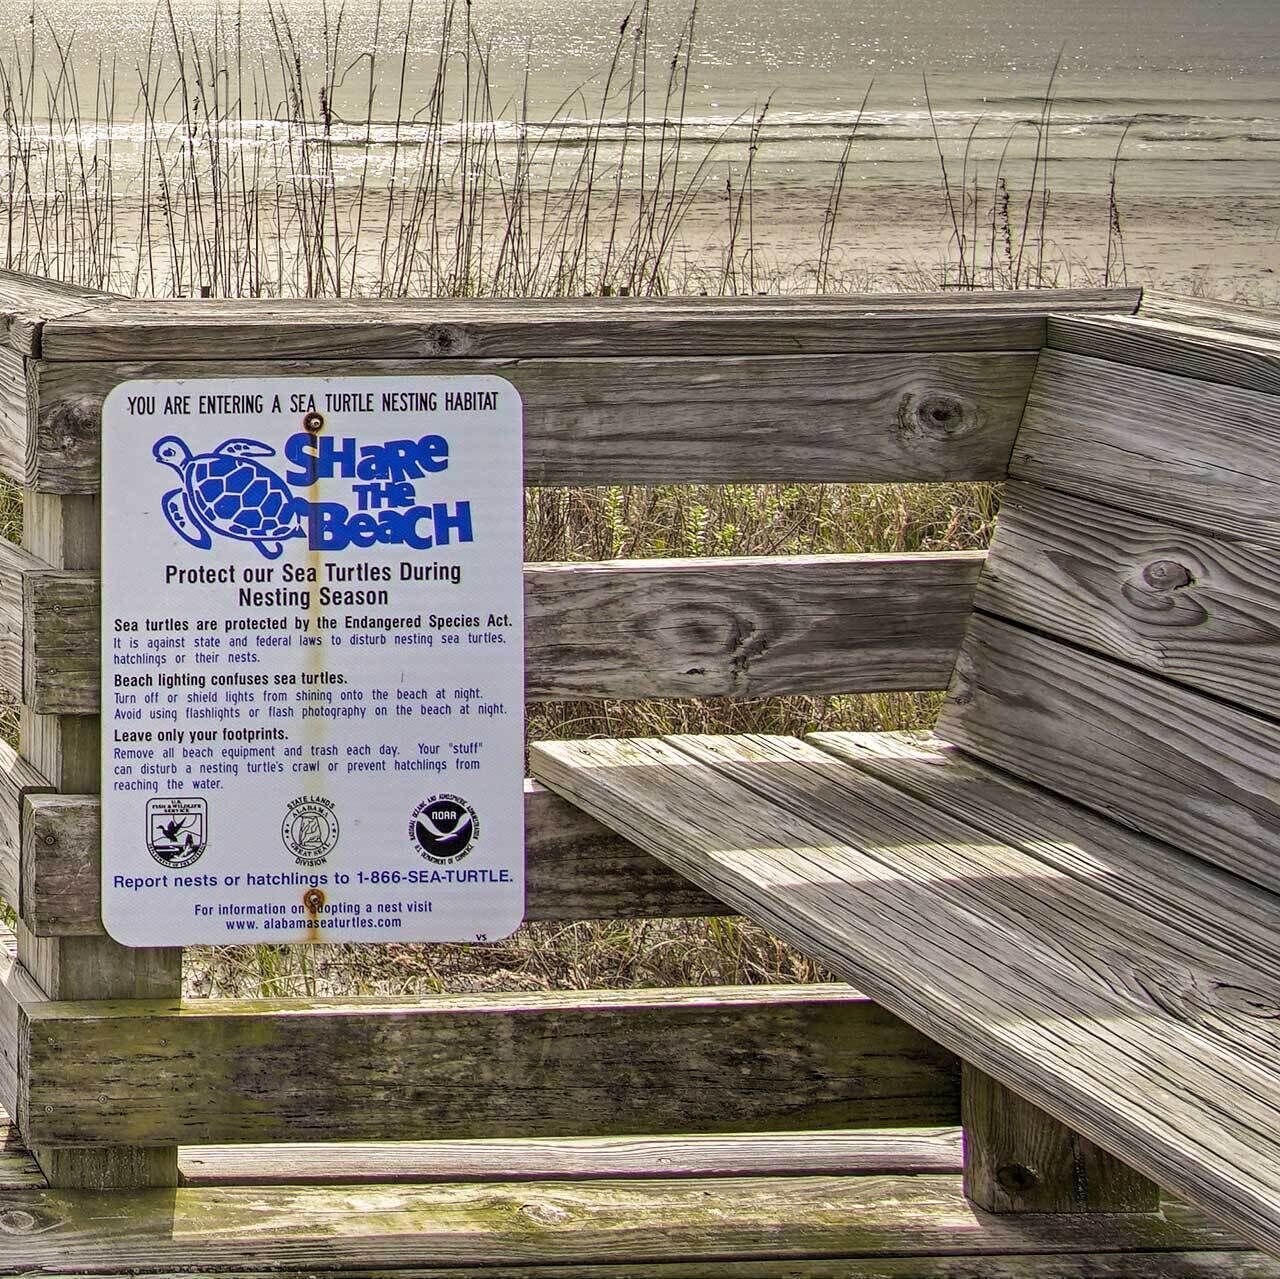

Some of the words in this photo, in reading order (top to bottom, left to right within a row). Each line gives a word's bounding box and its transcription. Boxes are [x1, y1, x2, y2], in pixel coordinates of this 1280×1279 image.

[127, 396, 155, 415] YOU
[164, 396, 191, 415] ARE
[199, 395, 263, 414] ENTERING
[272, 395, 281, 413] A
[290, 394, 316, 413] SEA
[325, 393, 374, 412] TURTLE
[382, 392, 437, 412] NESTING
[445, 392, 498, 411] HABITAT
[166, 565, 235, 584] Protect
[243, 568, 274, 583] our
[282, 563, 316, 582] Sea
[325, 563, 391, 582] Turtles
[400, 562, 460, 584] During
[239, 588, 310, 610] Nesting
[320, 587, 388, 605] Season
[115, 619, 138, 632] Sea
[145, 618, 188, 631] turtles
[197, 620, 217, 630] are
[225, 617, 287, 633] protected
[295, 617, 309, 632] by
[317, 616, 337, 629] the
[345, 615, 421, 631] Endangered
[429, 614, 480, 630] Species
[487, 614, 512, 627] Act.
[114, 638, 121, 648] It
[130, 637, 138, 648] is
[148, 637, 185, 651] against
[194, 637, 220, 647] state
[229, 636, 247, 647] and
[256, 635, 291, 646] federal
[300, 635, 322, 646] laws
[332, 635, 341, 645] to
[350, 634, 386, 645] disturb
[395, 633, 432, 647] nesting
[442, 635, 459, 643] sea
[468, 632, 505, 643] turtles.
[114, 653, 166, 667] hatchlings
[175, 655, 186, 663] or
[195, 653, 219, 663] their
[229, 652, 260, 662] nests.
[115, 674, 152, 687] Beach
[158, 673, 205, 689] lighting
[211, 673, 268, 685] confuses
[274, 675, 296, 685] sea
[301, 671, 347, 684] turtles.
[114, 693, 136, 704] Turn
[145, 692, 158, 703] off
[168, 694, 178, 703] or
[188, 691, 217, 702] shield
[226, 691, 254, 705] lights
[264, 690, 287, 701] from
[296, 689, 331, 704] shining
[341, 690, 363, 700] onto
[372, 689, 388, 700] the
[397, 689, 427, 699] beach
[436, 688, 445, 699] at
[454, 688, 483, 702] night.
[114, 708, 141, 719] Avoid
[150, 710, 177, 722] using
[186, 707, 240, 721] flashlights
[249, 709, 259, 717] or
[269, 706, 293, 717] flash
[302, 705, 366, 719] photography
[375, 707, 387, 715] on
[396, 704, 412, 715] the
[421, 704, 451, 715] beach
[460, 704, 469, 714] at
[478, 704, 507, 717] night.
[115, 729, 152, 742] Leave
[158, 729, 184, 744] only
[189, 731, 217, 744] your
[223, 727, 288, 743] footprints.
[114, 748, 154, 759] Remove
[163, 748, 174, 758] all
[183, 747, 213, 758] beach
[222, 746, 275, 759] equipment
[284, 745, 302, 756] and
[311, 745, 338, 756] trash
[347, 744, 370, 755] each
[379, 744, 400, 758] day.
[418, 743, 440, 754] Your
[449, 742, 482, 754] "stuff"
[114, 766, 132, 775] can
[141, 763, 177, 774] disturb
[186, 765, 191, 773] a
[200, 763, 238, 776] nesting
[247, 762, 284, 772] turtle's
[292, 761, 319, 772] crawl
[328, 763, 338, 771] or
[348, 760, 386, 773] prevent
[395, 759, 447, 773] hatchlings
[456, 758, 479, 769] from
[114, 780, 158, 793] reaching
[167, 779, 183, 789] the
[192, 779, 223, 789] water.
[287, 796, 307, 810] STATE
[311, 795, 335, 809] LANDS
[293, 805, 329, 818] ALABAMA
[432, 811, 456, 820] NOAA
[295, 857, 328, 867] DIVISION
[114, 875, 168, 891] Report
[175, 875, 217, 887] nests
[224, 876, 240, 886] or
[247, 872, 328, 888] hatchlings
[334, 872, 349, 884] to
[357, 870, 513, 884] 1-866-SEA-TURTLE.
[195, 904, 213, 915] For
[219, 903, 285, 915] information
[291, 905, 304, 914] on
[366, 904, 372, 913] a
[378, 902, 402, 912] nest
[407, 901, 432, 912] visit
[226, 921, 258, 929] www.
[264, 917, 401, 929] alabamaseaturtles.com
